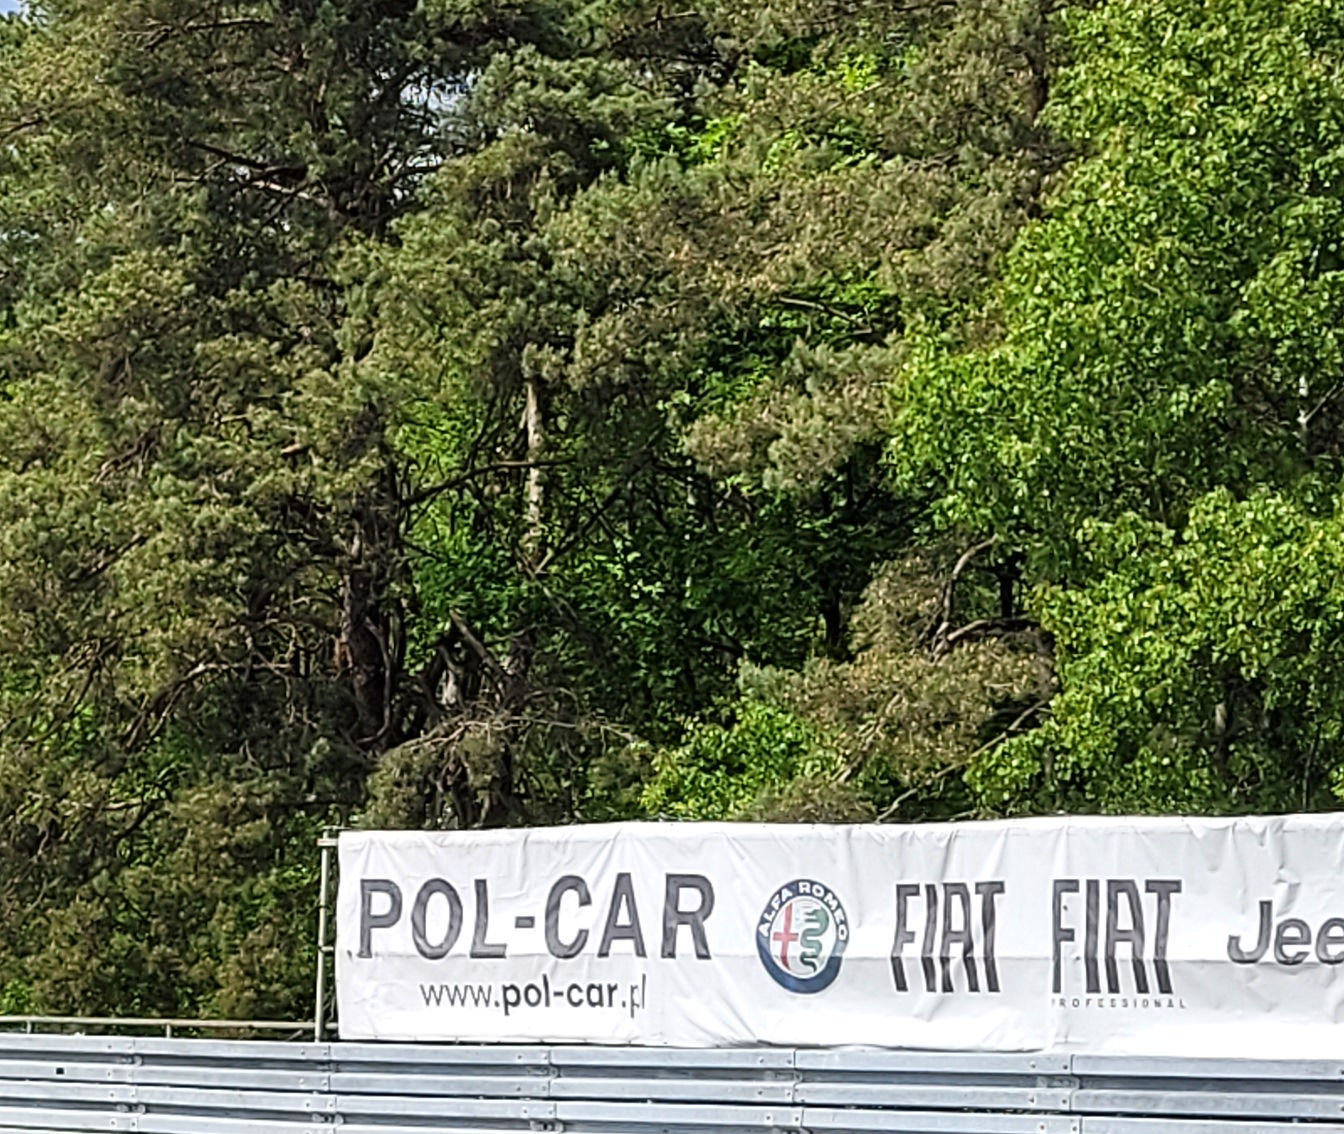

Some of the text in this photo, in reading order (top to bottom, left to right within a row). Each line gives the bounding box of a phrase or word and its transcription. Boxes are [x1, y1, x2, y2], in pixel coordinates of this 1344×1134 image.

[357, 872, 715, 961] POL-CAR
[758, 881, 848, 941] ALFA ROMEO
[890, 880, 1006, 993] FIAT
[1051, 879, 1182, 994] FIAT
[419, 973, 646, 1018] www.pol-car.pl
[1052, 998, 1187, 1009] PROFESSIONAL
